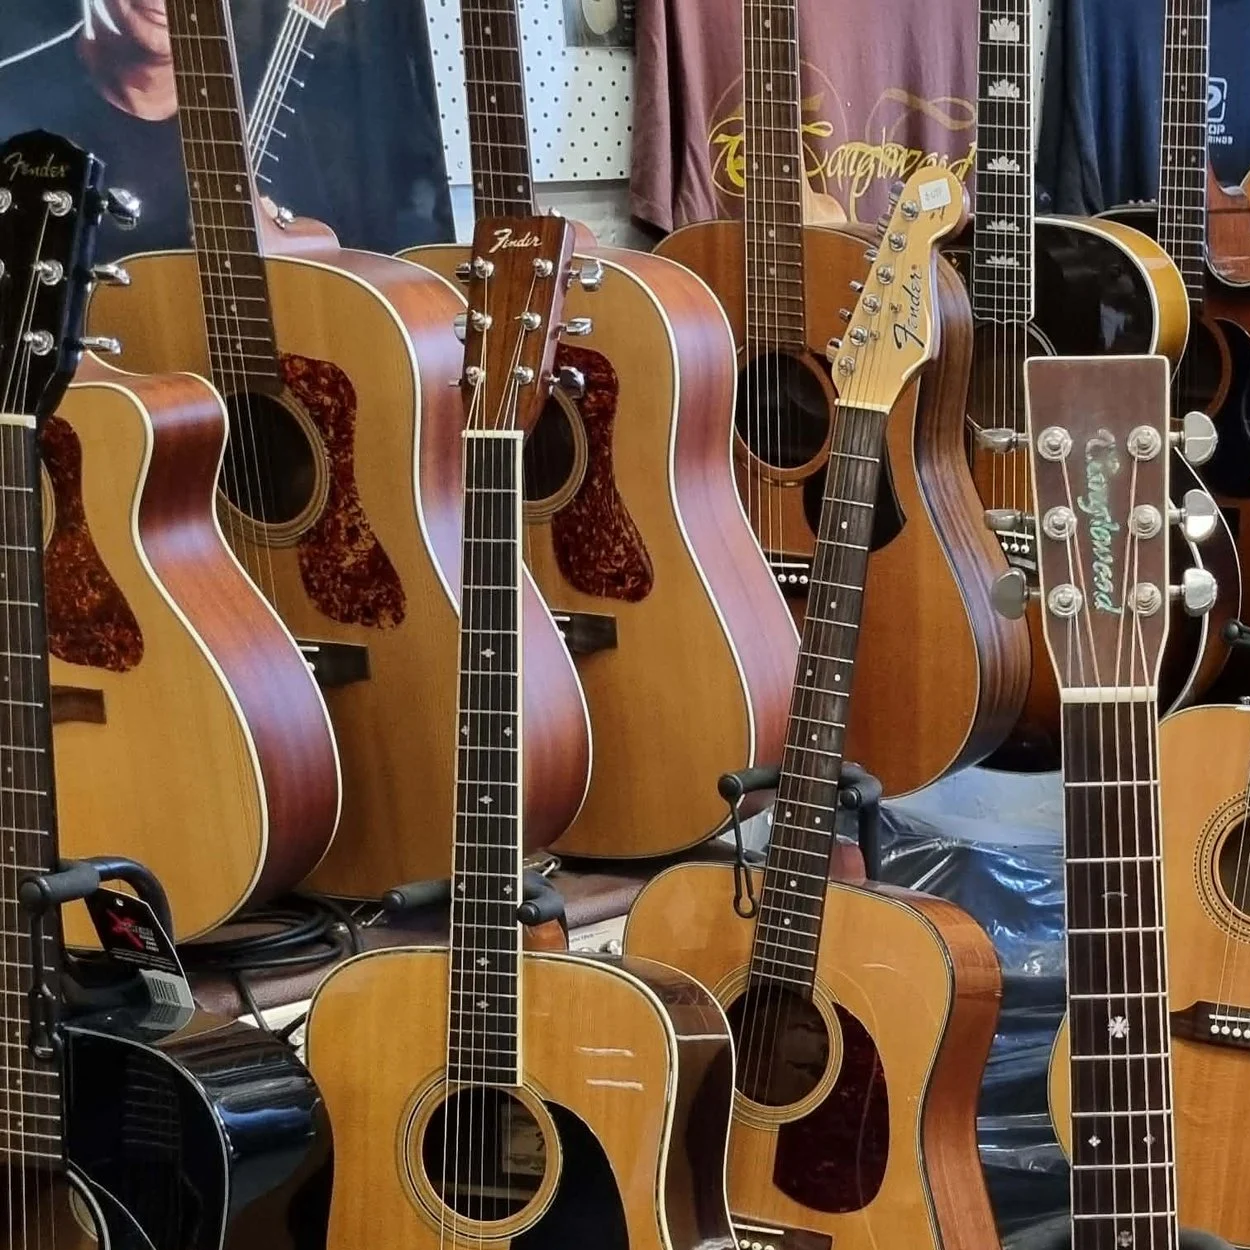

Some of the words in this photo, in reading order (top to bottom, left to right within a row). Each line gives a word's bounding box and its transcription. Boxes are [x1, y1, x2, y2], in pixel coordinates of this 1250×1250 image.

[3, 151, 67, 182] Fender
[488, 228, 544, 254] Fender
[893, 270, 926, 350] Fender
